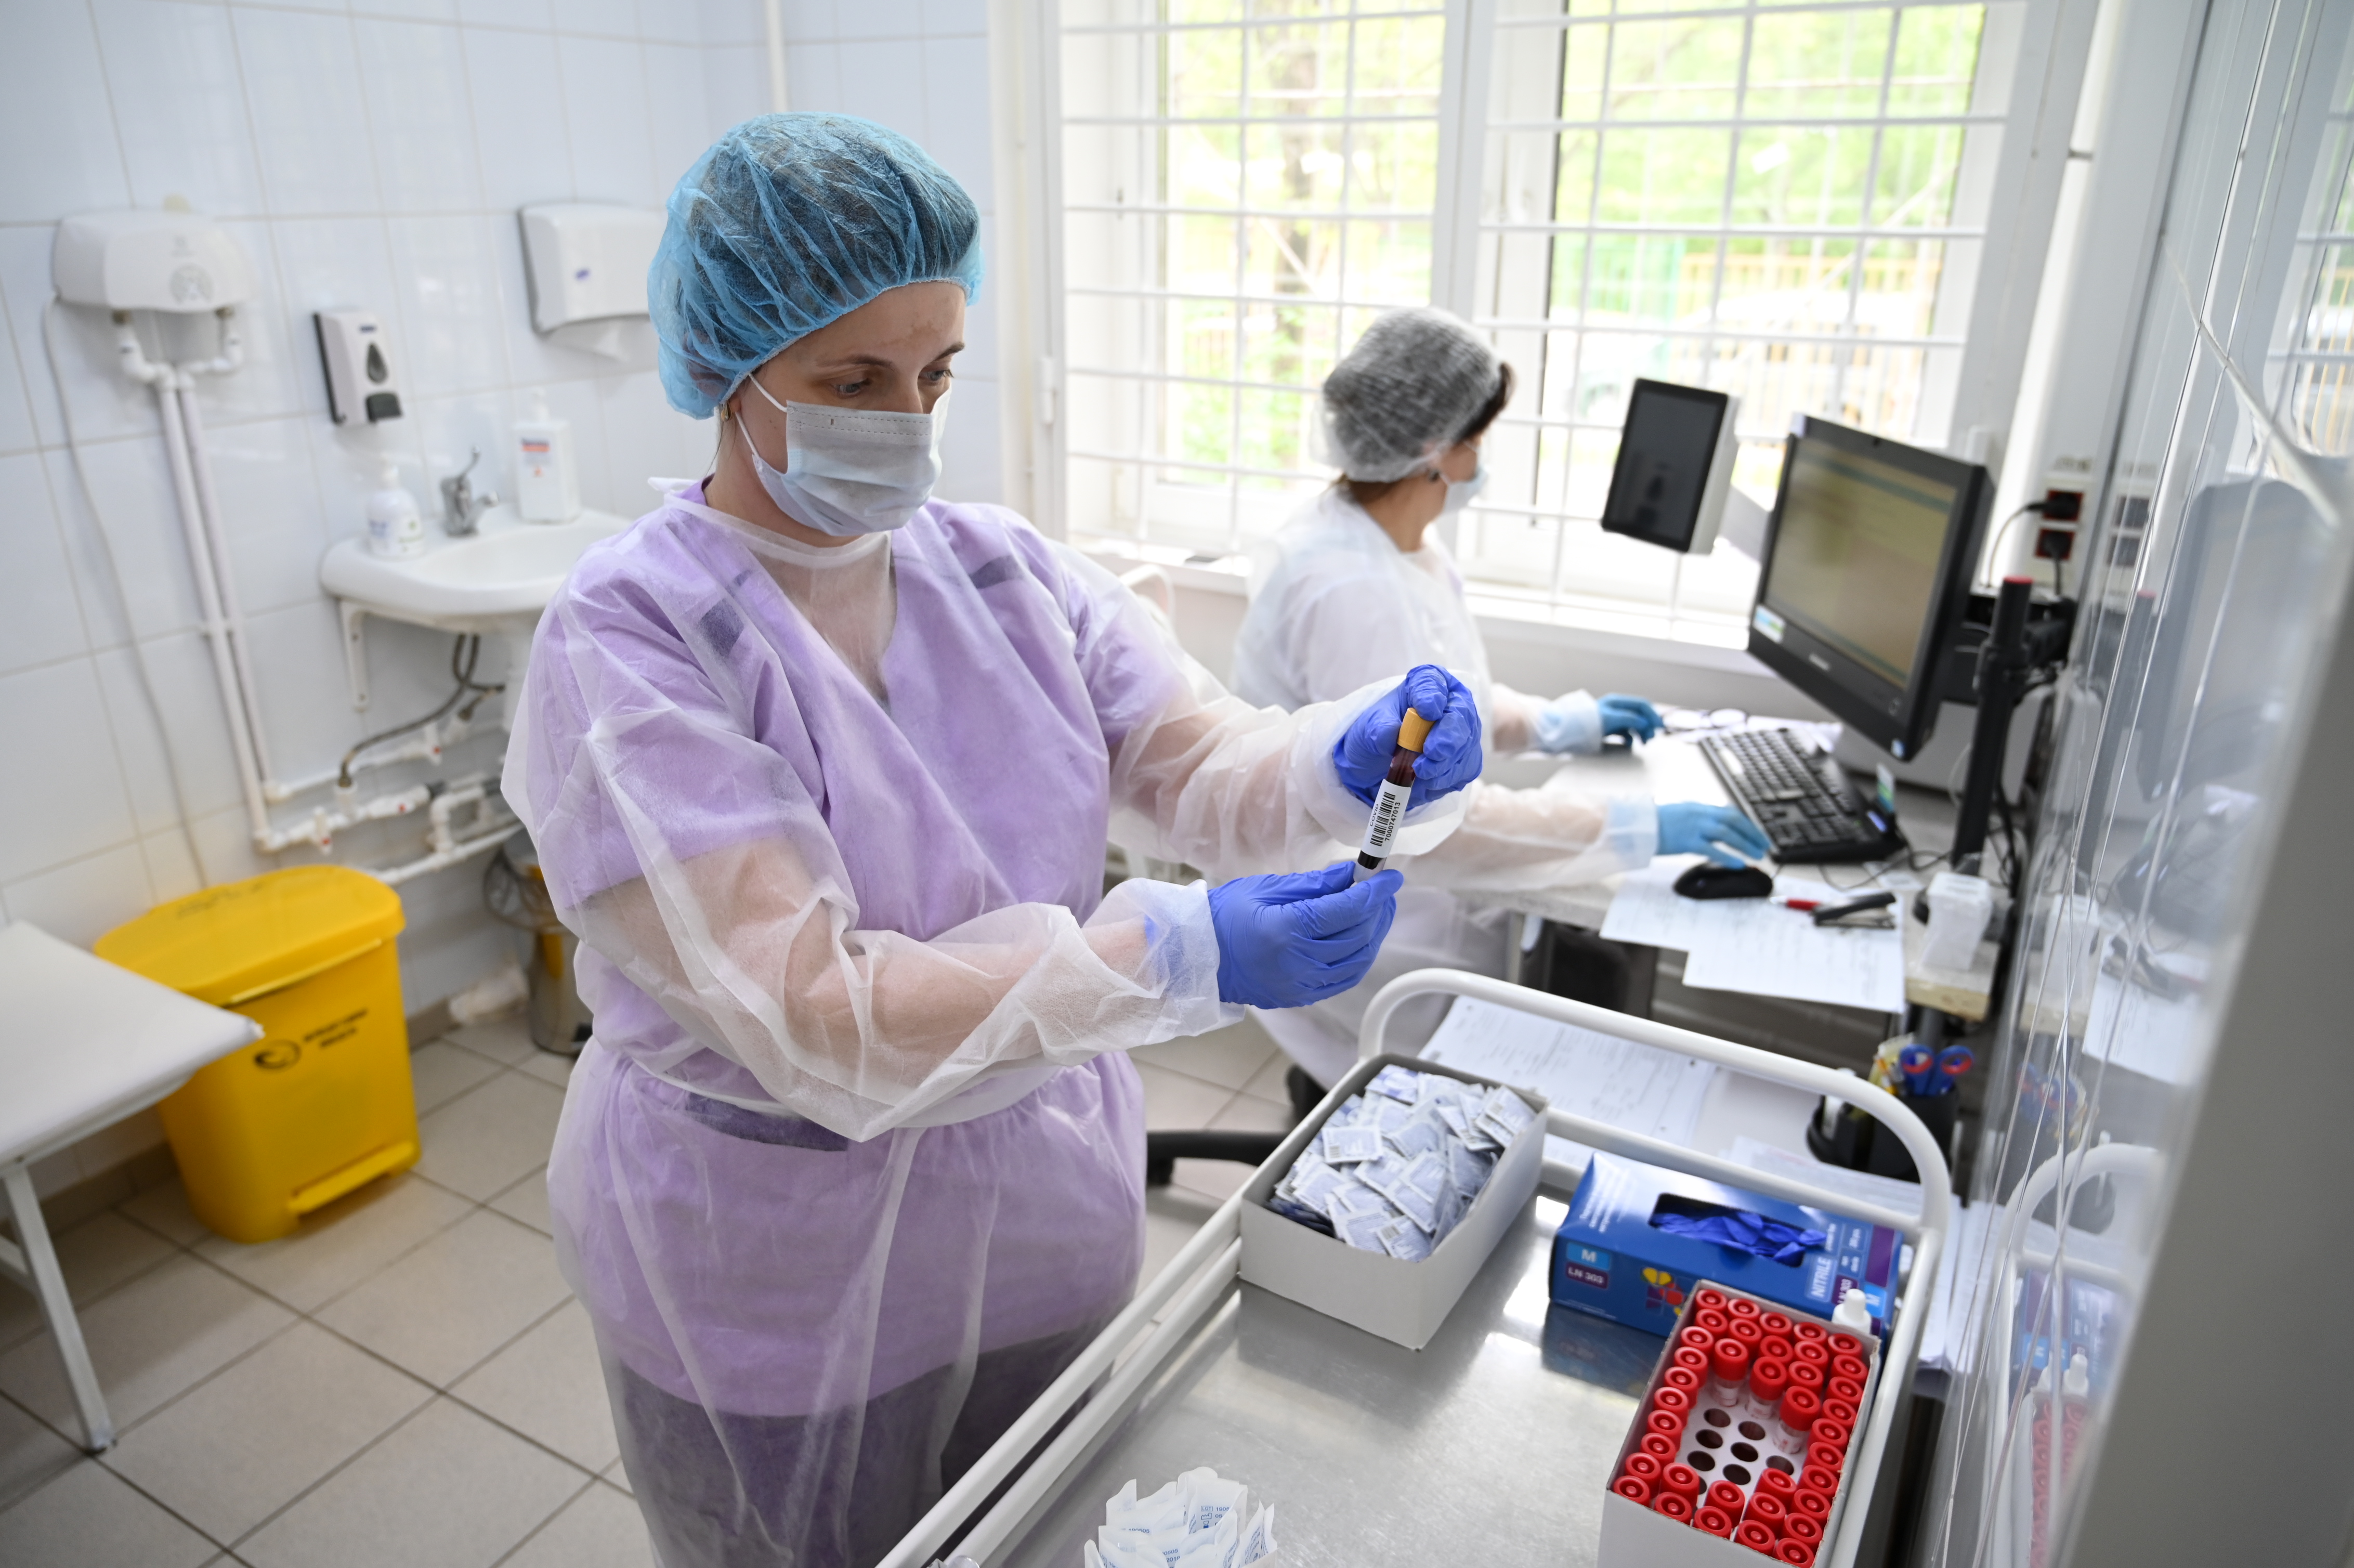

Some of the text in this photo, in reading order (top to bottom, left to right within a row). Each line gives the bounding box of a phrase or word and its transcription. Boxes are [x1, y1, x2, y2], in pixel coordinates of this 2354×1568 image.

[1370, 804, 1379, 827] COVID
[1384, 802, 1401, 841] 7000747013
[1581, 1249, 1597, 1263] M
[1811, 1257, 1831, 1298] NITRILE
